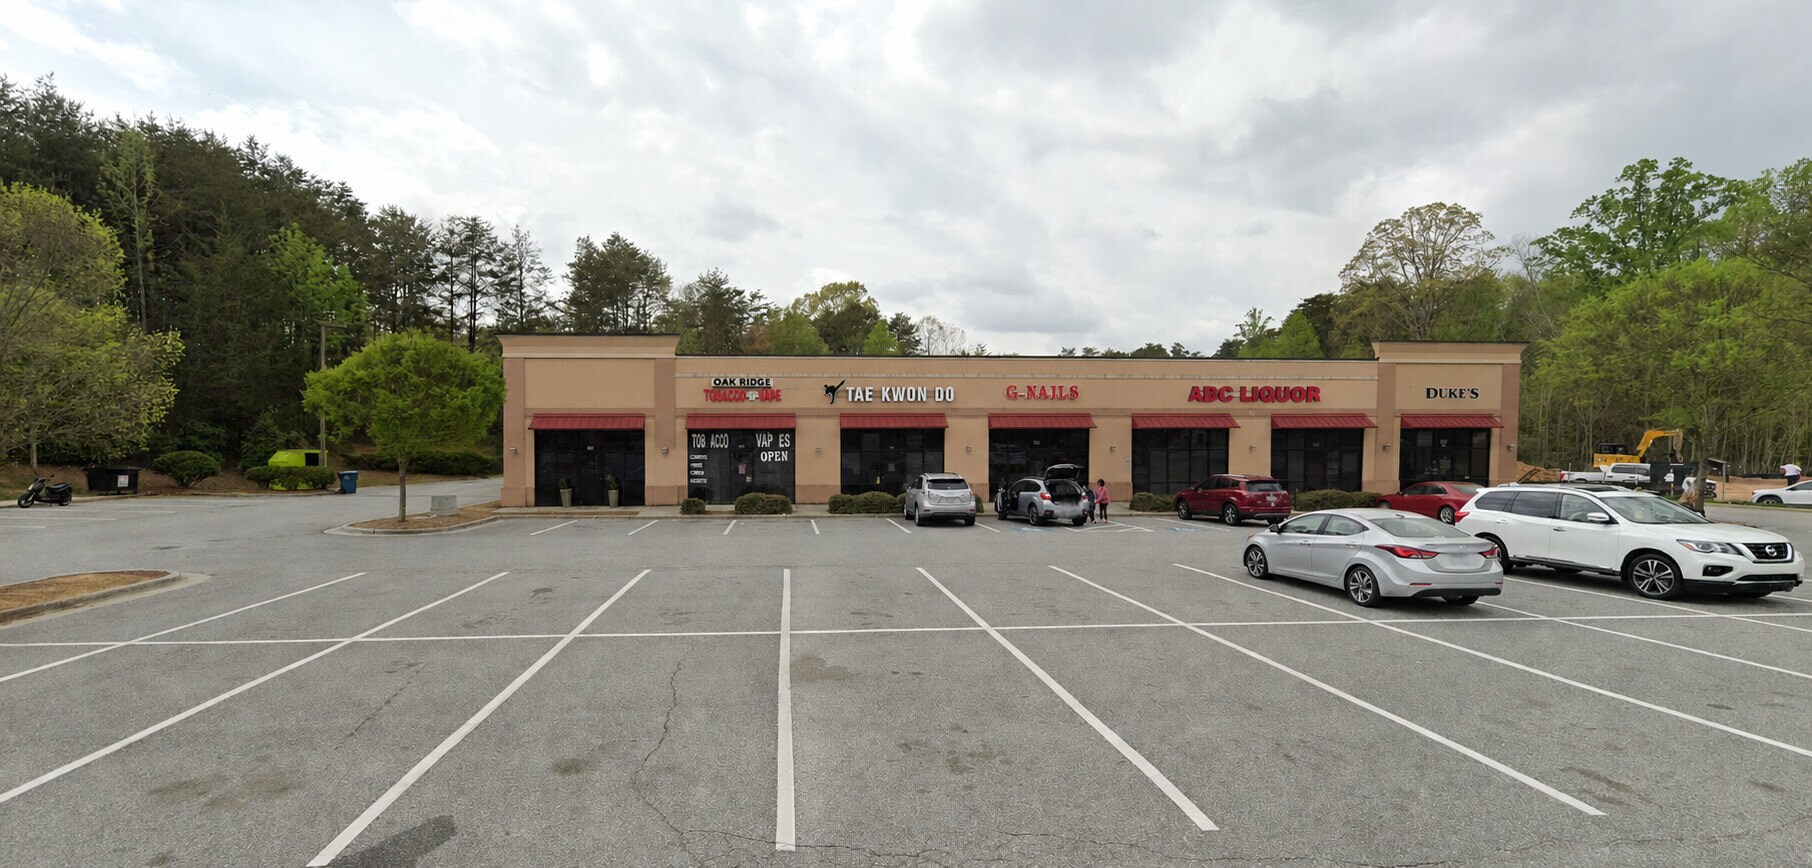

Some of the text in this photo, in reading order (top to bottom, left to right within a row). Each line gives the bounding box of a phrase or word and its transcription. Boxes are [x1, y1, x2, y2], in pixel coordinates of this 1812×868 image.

[713, 378, 771, 386] OAK RIDGE
[703, 388, 782, 402] TOBACCO VAPE
[846, 386, 955, 402] TAE KWON DO
[1005, 385, 1079, 400] G-NAILS
[1187, 385, 1321, 403] ABC LIQUOR
[1425, 387, 1479, 399] DUKE'S
[760, 450, 788, 462] OPEN
